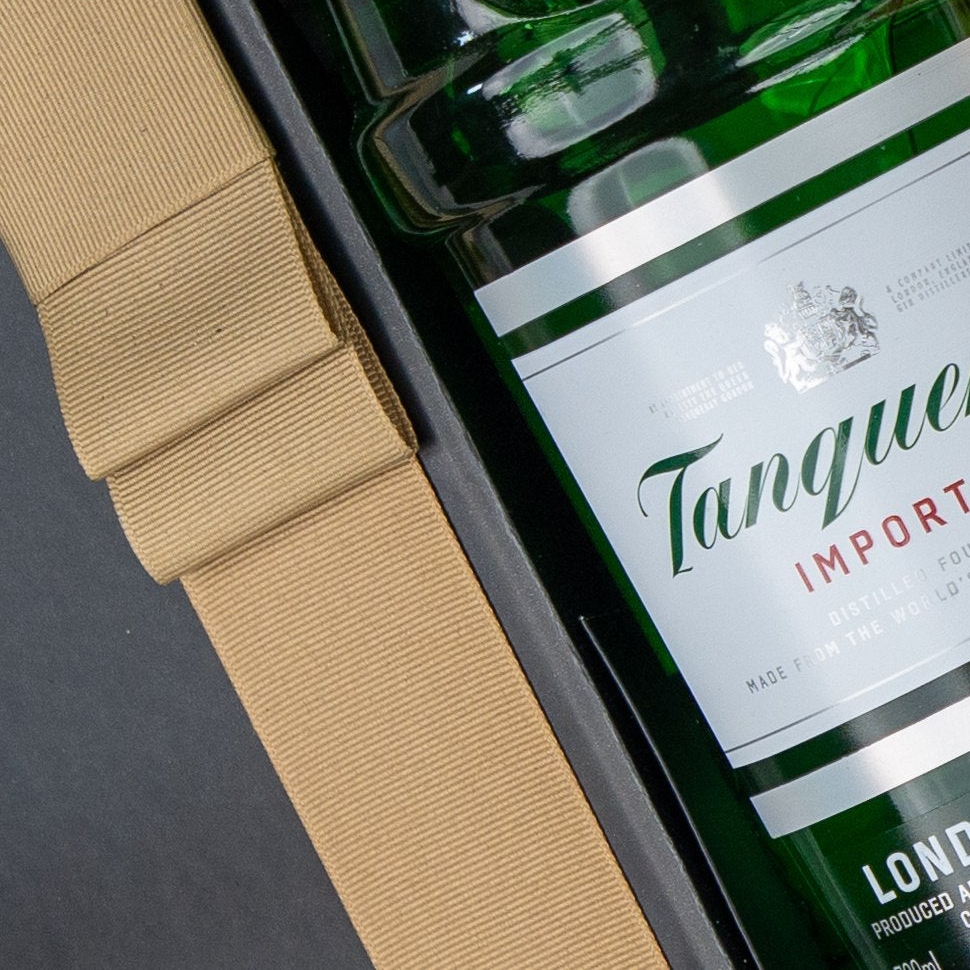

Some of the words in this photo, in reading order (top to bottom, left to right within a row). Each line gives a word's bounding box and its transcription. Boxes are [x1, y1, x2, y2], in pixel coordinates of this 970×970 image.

[828, 569, 928, 627] DISTILLED
[746, 666, 788, 694] MADE
[794, 641, 841, 672] FROM
[845, 620, 884, 647] THE
[871, 892, 955, 940] PRODUCED
